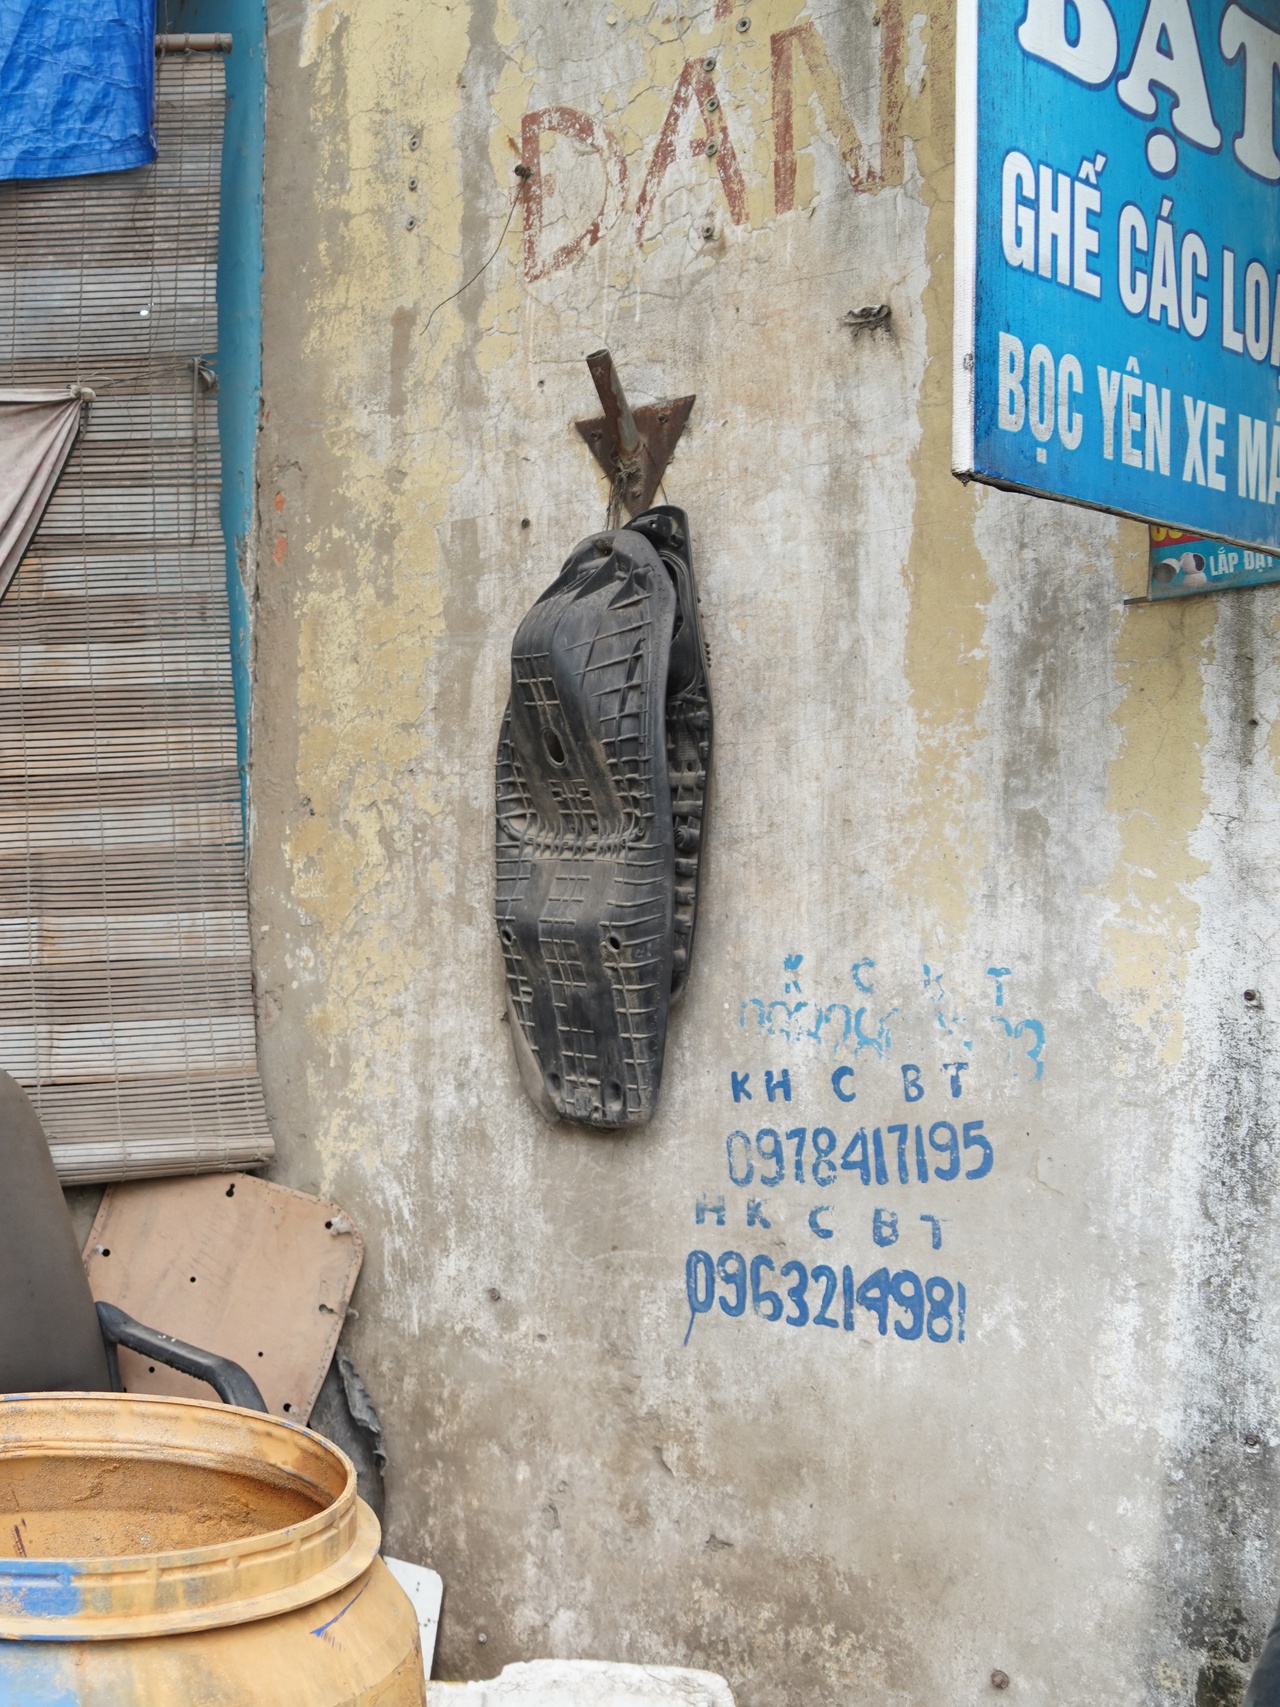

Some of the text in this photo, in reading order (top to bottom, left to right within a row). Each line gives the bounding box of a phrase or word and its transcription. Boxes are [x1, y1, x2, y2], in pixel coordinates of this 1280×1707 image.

[1001, 151, 1280, 390] GHẾ CÁC LO
[998, 330, 1084, 465] BỌC
[1096, 355, 1171, 476] YÊN
[1182, 393, 1226, 492] XE
[726, 1119, 994, 1188] 0978417195
[684, 1249, 967, 1346] 0963214981
